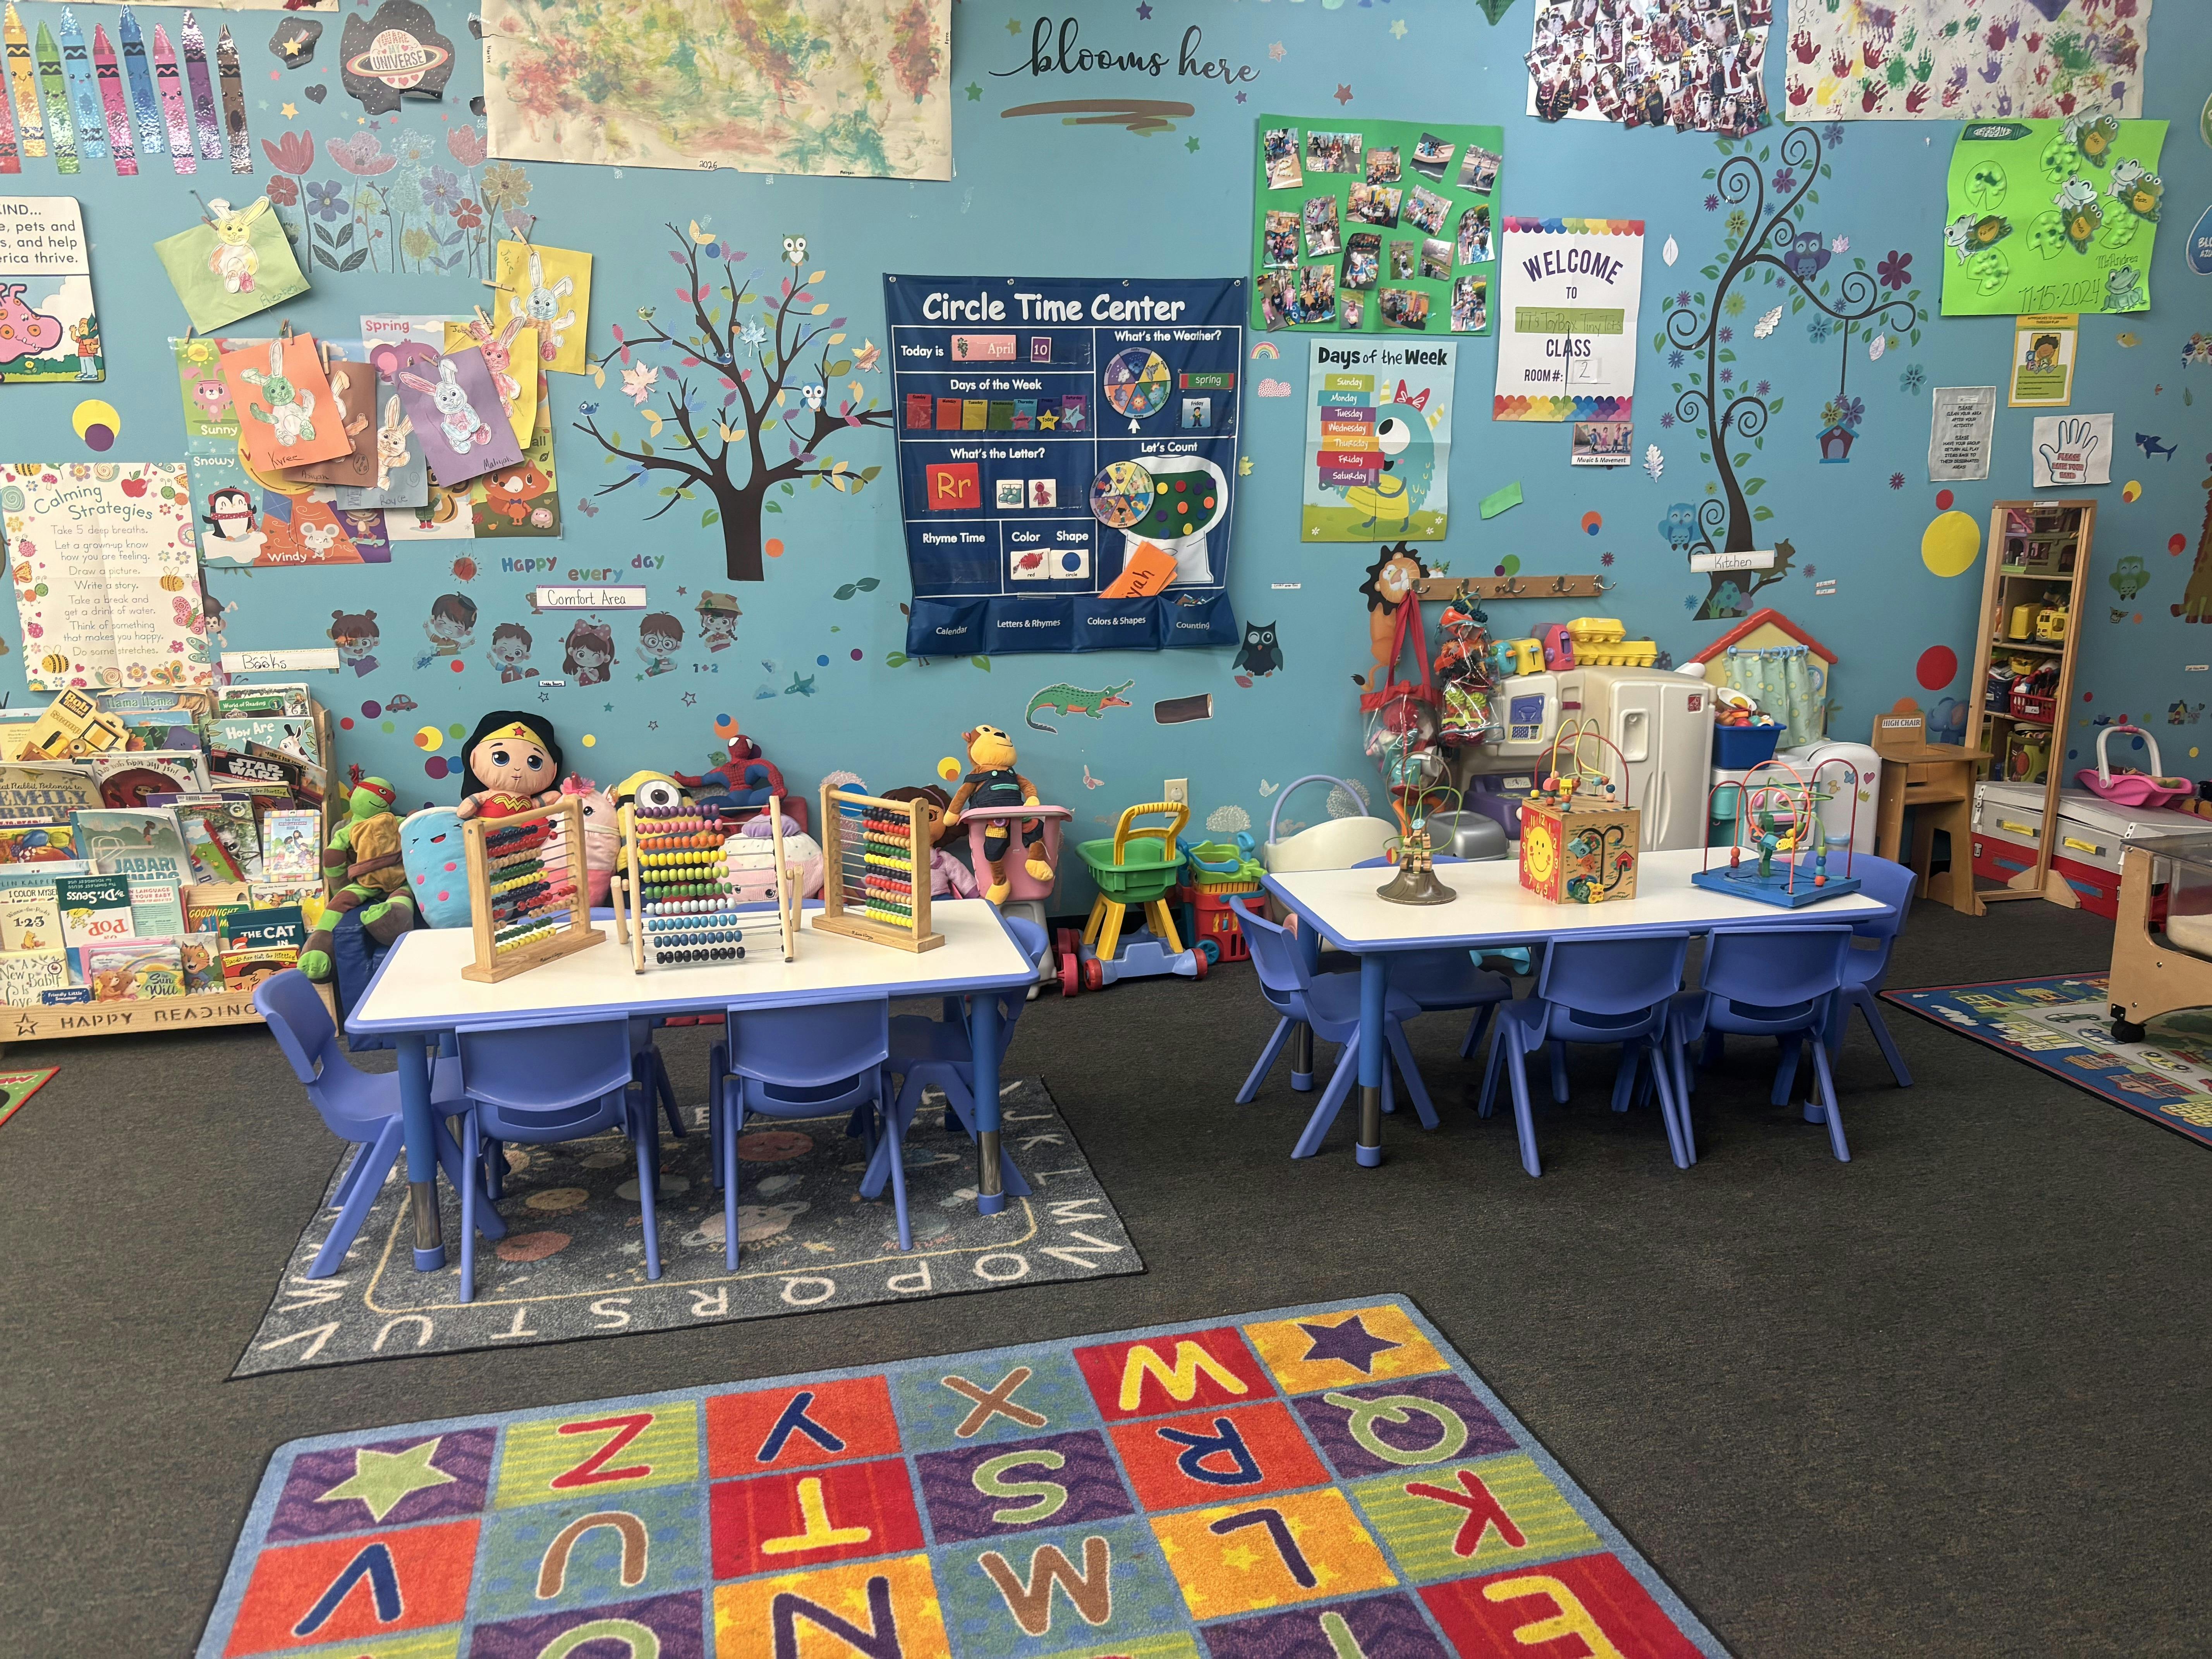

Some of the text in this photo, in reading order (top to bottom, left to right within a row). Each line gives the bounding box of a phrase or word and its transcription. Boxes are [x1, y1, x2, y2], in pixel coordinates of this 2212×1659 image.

[989, 17, 1260, 84] blooms here
[373, 50, 424, 69] UNIVERSE
[699, 161, 717, 169] 2026
[16, 220, 75, 234] pets and
[17, 236, 77, 249] and help
[35, 252, 78, 263] thrive.
[1522, 248, 1623, 285] WELCOME
[1566, 287, 1577, 299] TO
[923, 292, 1185, 322] Circle Time Center
[365, 320, 409, 333] Spring
[1580, 312, 1601, 337] Tiny
[1601, 314, 1622, 331] Tots
[1115, 330, 1221, 342] What's the Weather?
[901, 345, 944, 359] Today is
[988, 343, 1015, 358] April
[1034, 344, 1048, 355] 10
[1546, 339, 1591, 357] CLASS
[1318, 347, 1448, 369] Days of the Week
[1524, 369, 1551, 381] ROOM
[1579, 361, 1590, 379] 2
[950, 379, 1042, 393] Days of the Week
[1195, 375, 1221, 386] spring
[1337, 378, 1362, 389] Sunday
[1330, 394, 1357, 405] Monday
[1335, 409, 1363, 418] Tuesday
[201, 425, 237, 436] Sunny
[1328, 423, 1366, 434] Wednesday
[951, 448, 1045, 459] What's the Letter?
[1142, 442, 1197, 453] Let's Count
[194, 457, 235, 467] Snowy
[484, 456, 514, 471] Maliyah
[937, 472, 971, 499] Rr
[34, 486, 102, 514] Calming
[380, 494, 408, 506] Royce
[68, 504, 152, 522] Strategies
[51, 524, 148, 536] Take 5 deep breaths.
[1012, 530, 1089, 543] Color Shape
[923, 532, 985, 545] Rhyme Time
[83, 542, 122, 554] grown-up
[62, 552, 79, 560] how
[82, 553, 98, 563] you
[119, 552, 150, 563] feeling.
[267, 553, 307, 562] Windy
[1714, 555, 1752, 568] Kitchen
[69, 566, 96, 575] Draw
[109, 567, 140, 577] picture.
[501, 554, 665, 583] Happy every day
[74, 580, 102, 590] Write
[115, 582, 138, 592] story.
[68, 595, 90, 605] Take
[104, 595, 129, 604] break
[132, 595, 149, 603] and
[548, 589, 625, 606] Comfort Area
[65, 608, 77, 619] get
[92, 606, 114, 615] drink
[117, 606, 125, 615] of
[129, 607, 156, 615] water.
[69, 621, 155, 634] Think of something
[998, 620, 1023, 628] Letters
[1032, 619, 1061, 628] Rhymes
[1087, 617, 1111, 625] Colors
[1120, 617, 1146, 625] Shapes
[64, 632, 163, 643] that makes you happy.
[936, 627, 967, 635] Calendar
[72, 647, 87, 656] Do
[242, 654, 287, 670] Books
[63, 700, 85, 716] Builder
[65, 692, 90, 712] Bob
[50, 710, 82, 734] Scoop
[225, 722, 275, 740] How Are
[229, 758, 283, 773] STAR
[229, 765, 283, 781] WARS
[39, 783, 72, 791] Belongs
[0, 790, 89, 805] EMILY
[115, 857, 178, 873] JABARI
[67, 889, 117, 903] Dr. Seuss
[189, 908, 239, 918] GOODNIGHT
[88, 919, 128, 936] POP
[263, 925, 295, 939] CAT
[149, 973, 174, 984] Sun
[146, 984, 178, 995] Will
[61, 1013, 133, 1029] HAPPY
[939, 1366, 1048, 1438] X
[756, 1392, 845, 1463] Y
[550, 1413, 655, 1490] Z
